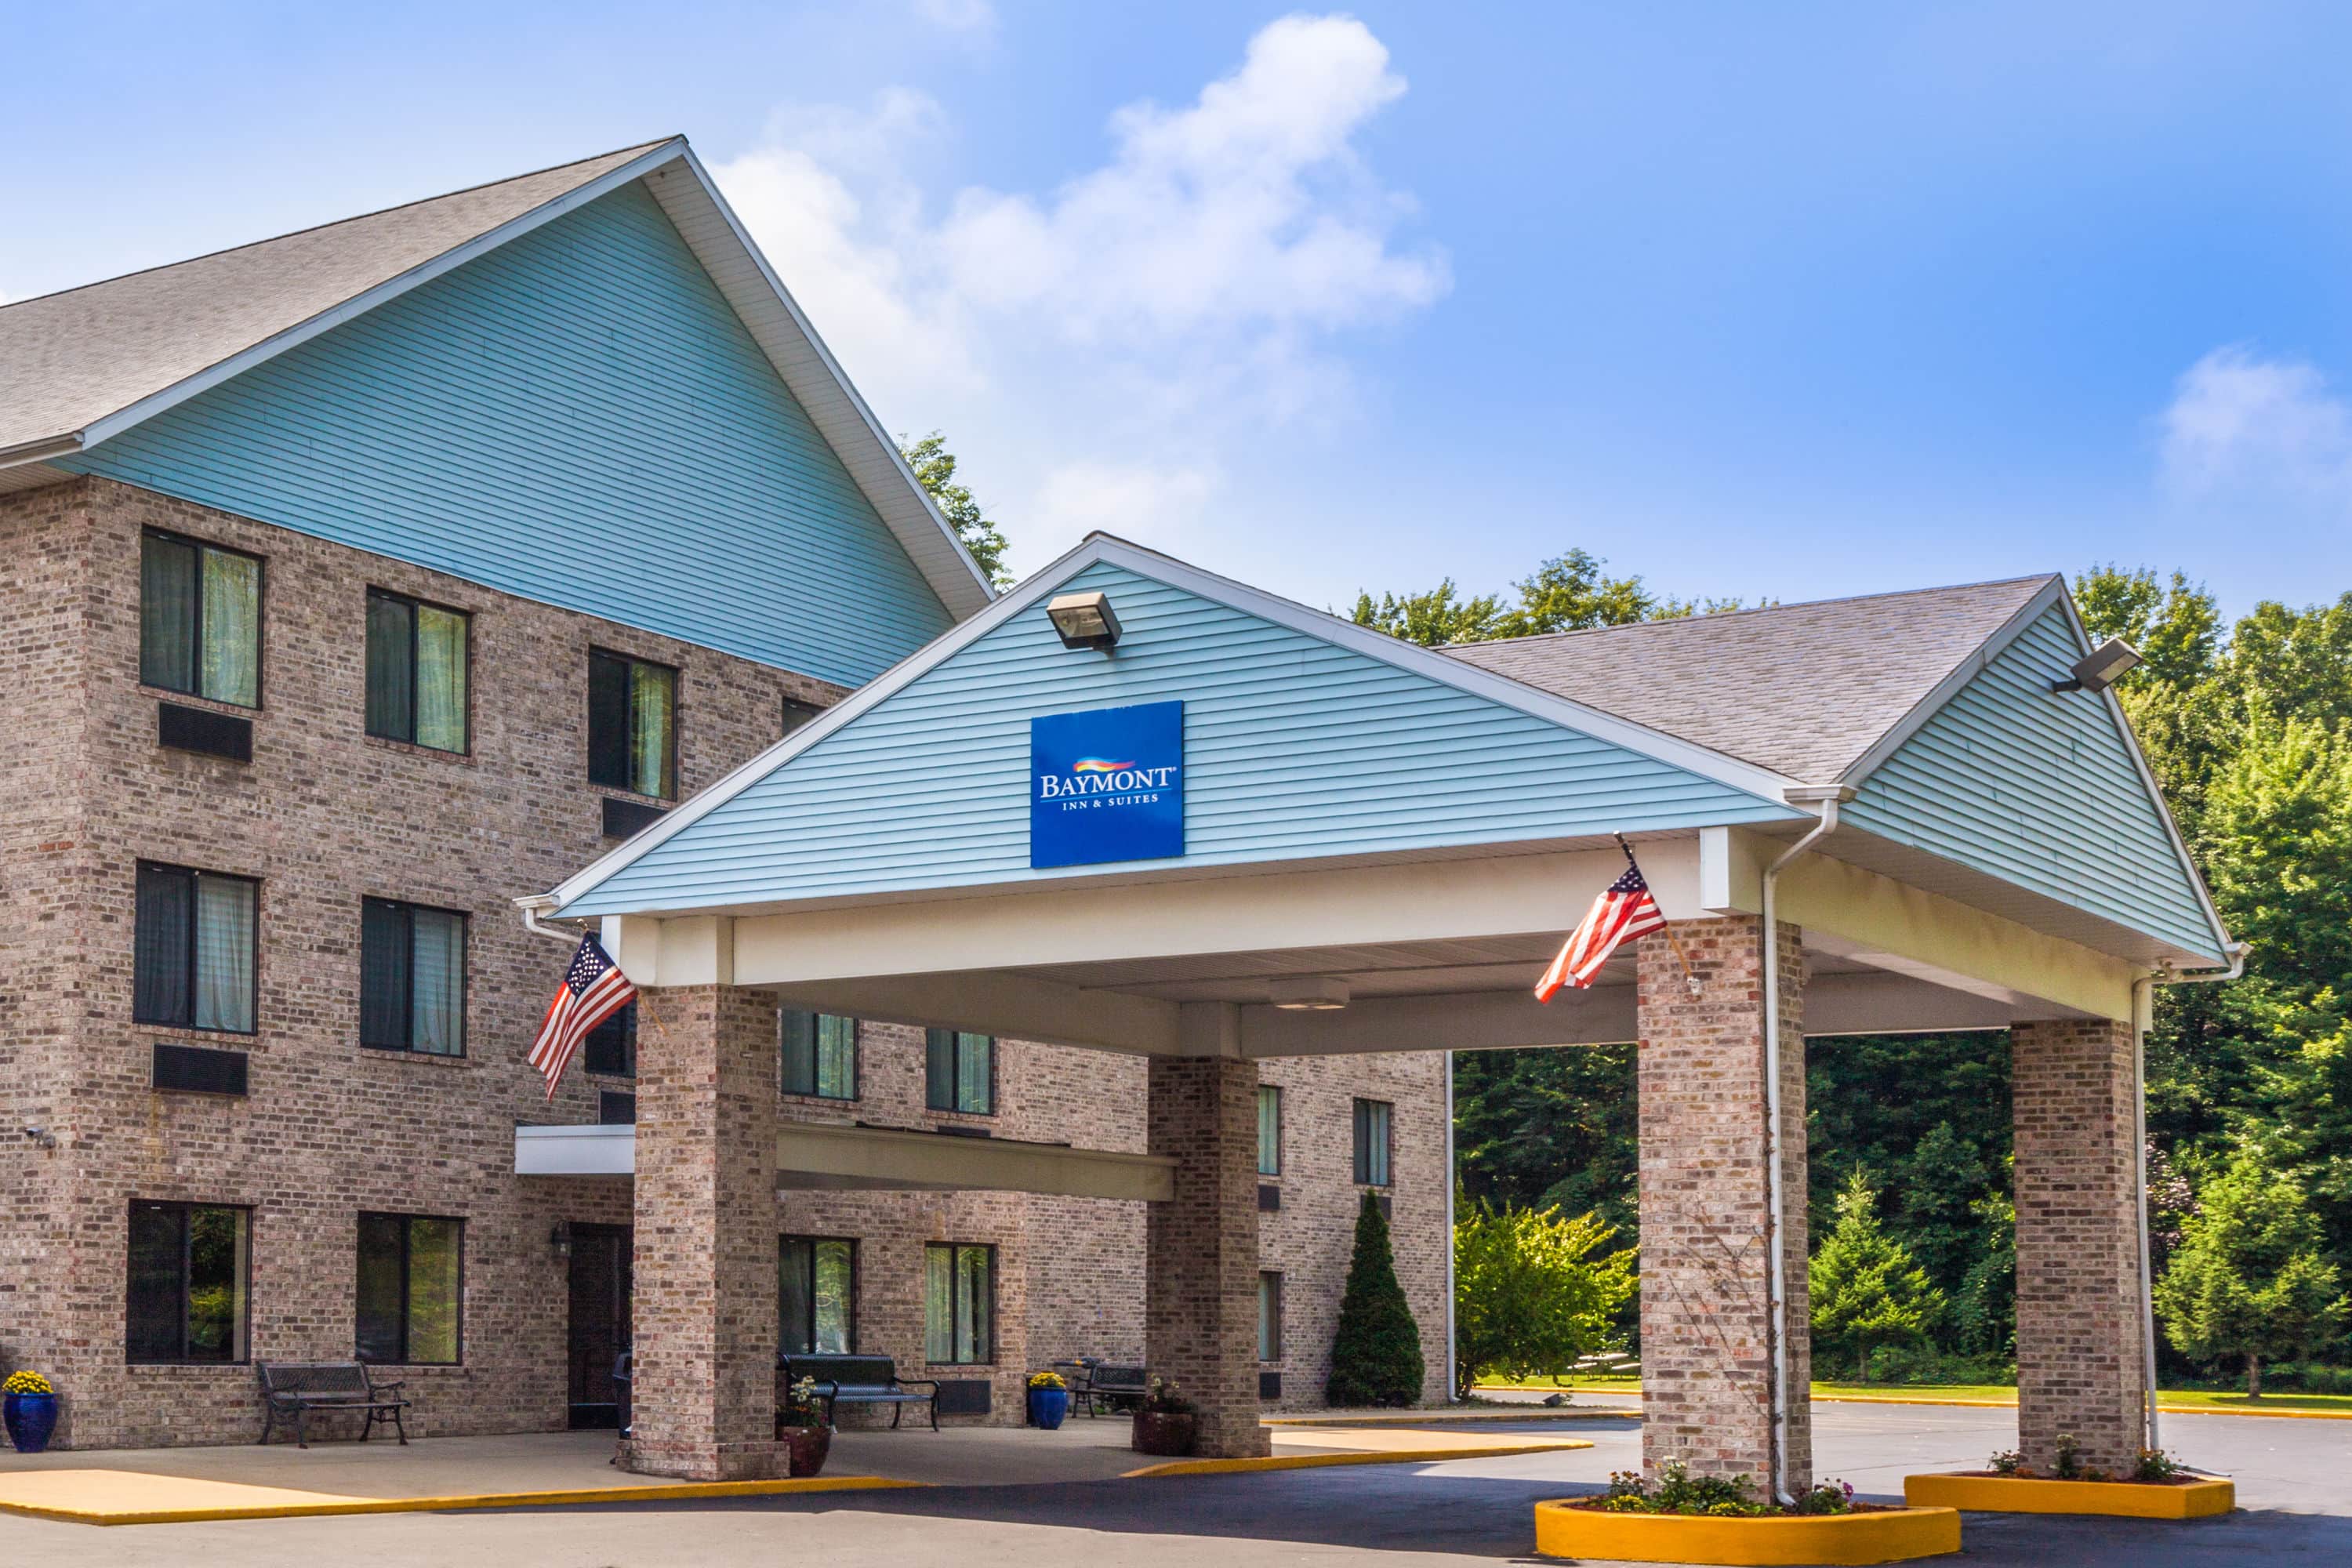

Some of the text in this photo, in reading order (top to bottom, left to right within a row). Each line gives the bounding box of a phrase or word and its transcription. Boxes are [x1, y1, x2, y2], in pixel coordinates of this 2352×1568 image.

[1063, 794, 1159, 811] INN & SUITES
